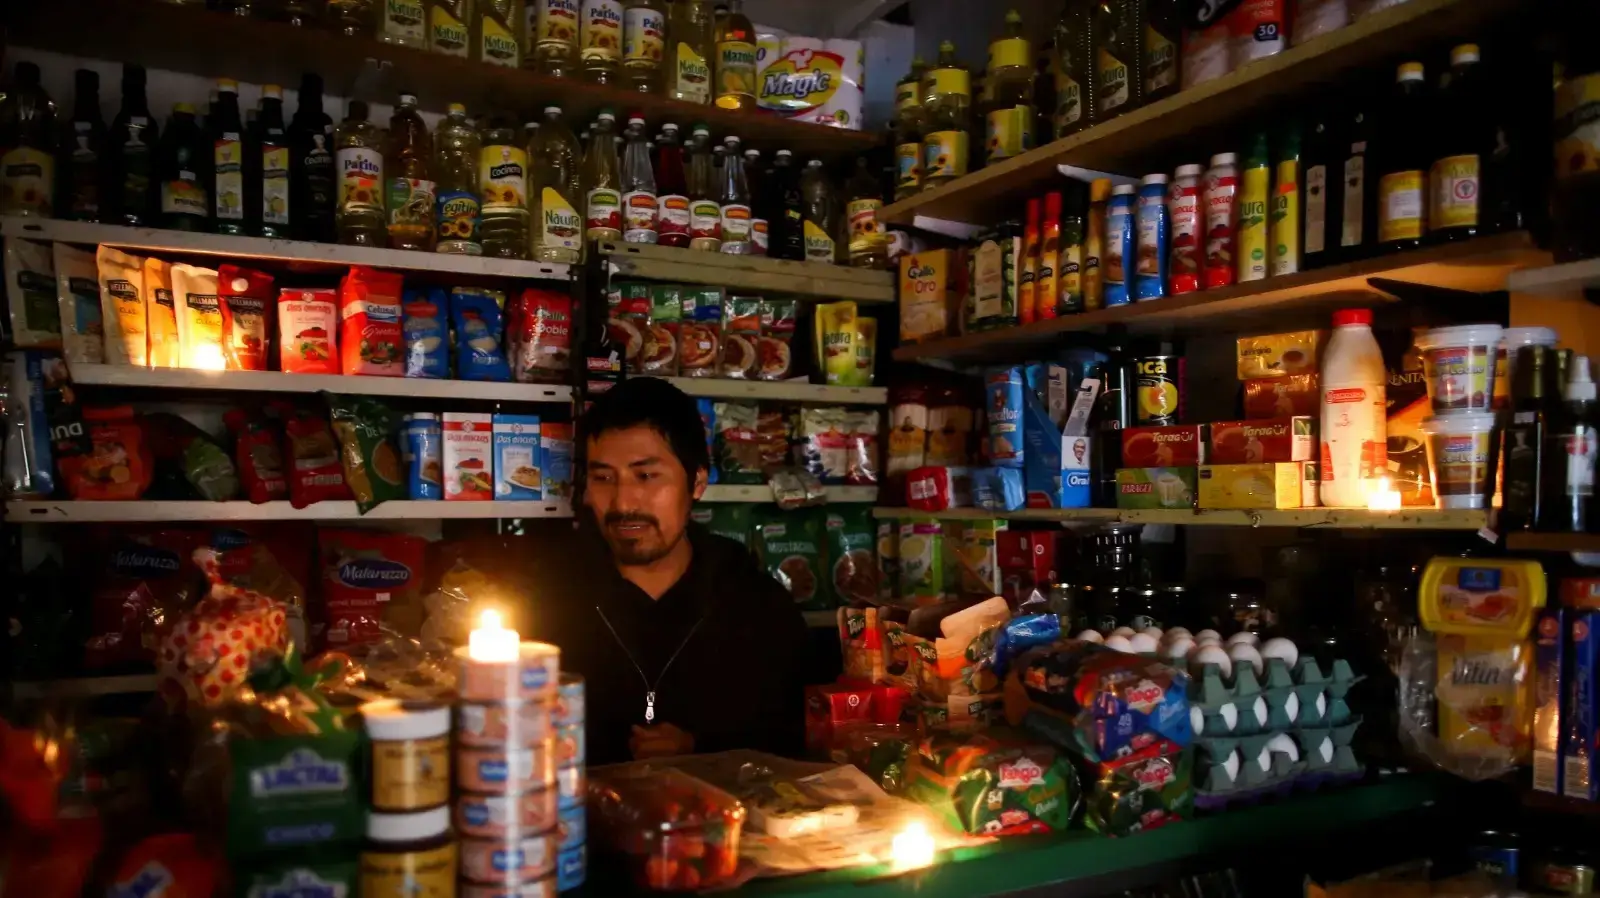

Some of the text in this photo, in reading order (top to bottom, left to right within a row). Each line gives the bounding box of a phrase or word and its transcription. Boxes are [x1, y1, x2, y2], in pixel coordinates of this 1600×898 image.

[590, 8, 621, 21] Patito
[1258, 24, 1277, 36] 30
[484, 35, 516, 51] Natura
[761, 68, 830, 98] Magic
[345, 159, 379, 172] Patito
[545, 209, 580, 227] Natura
[540, 323, 568, 335] Doble
